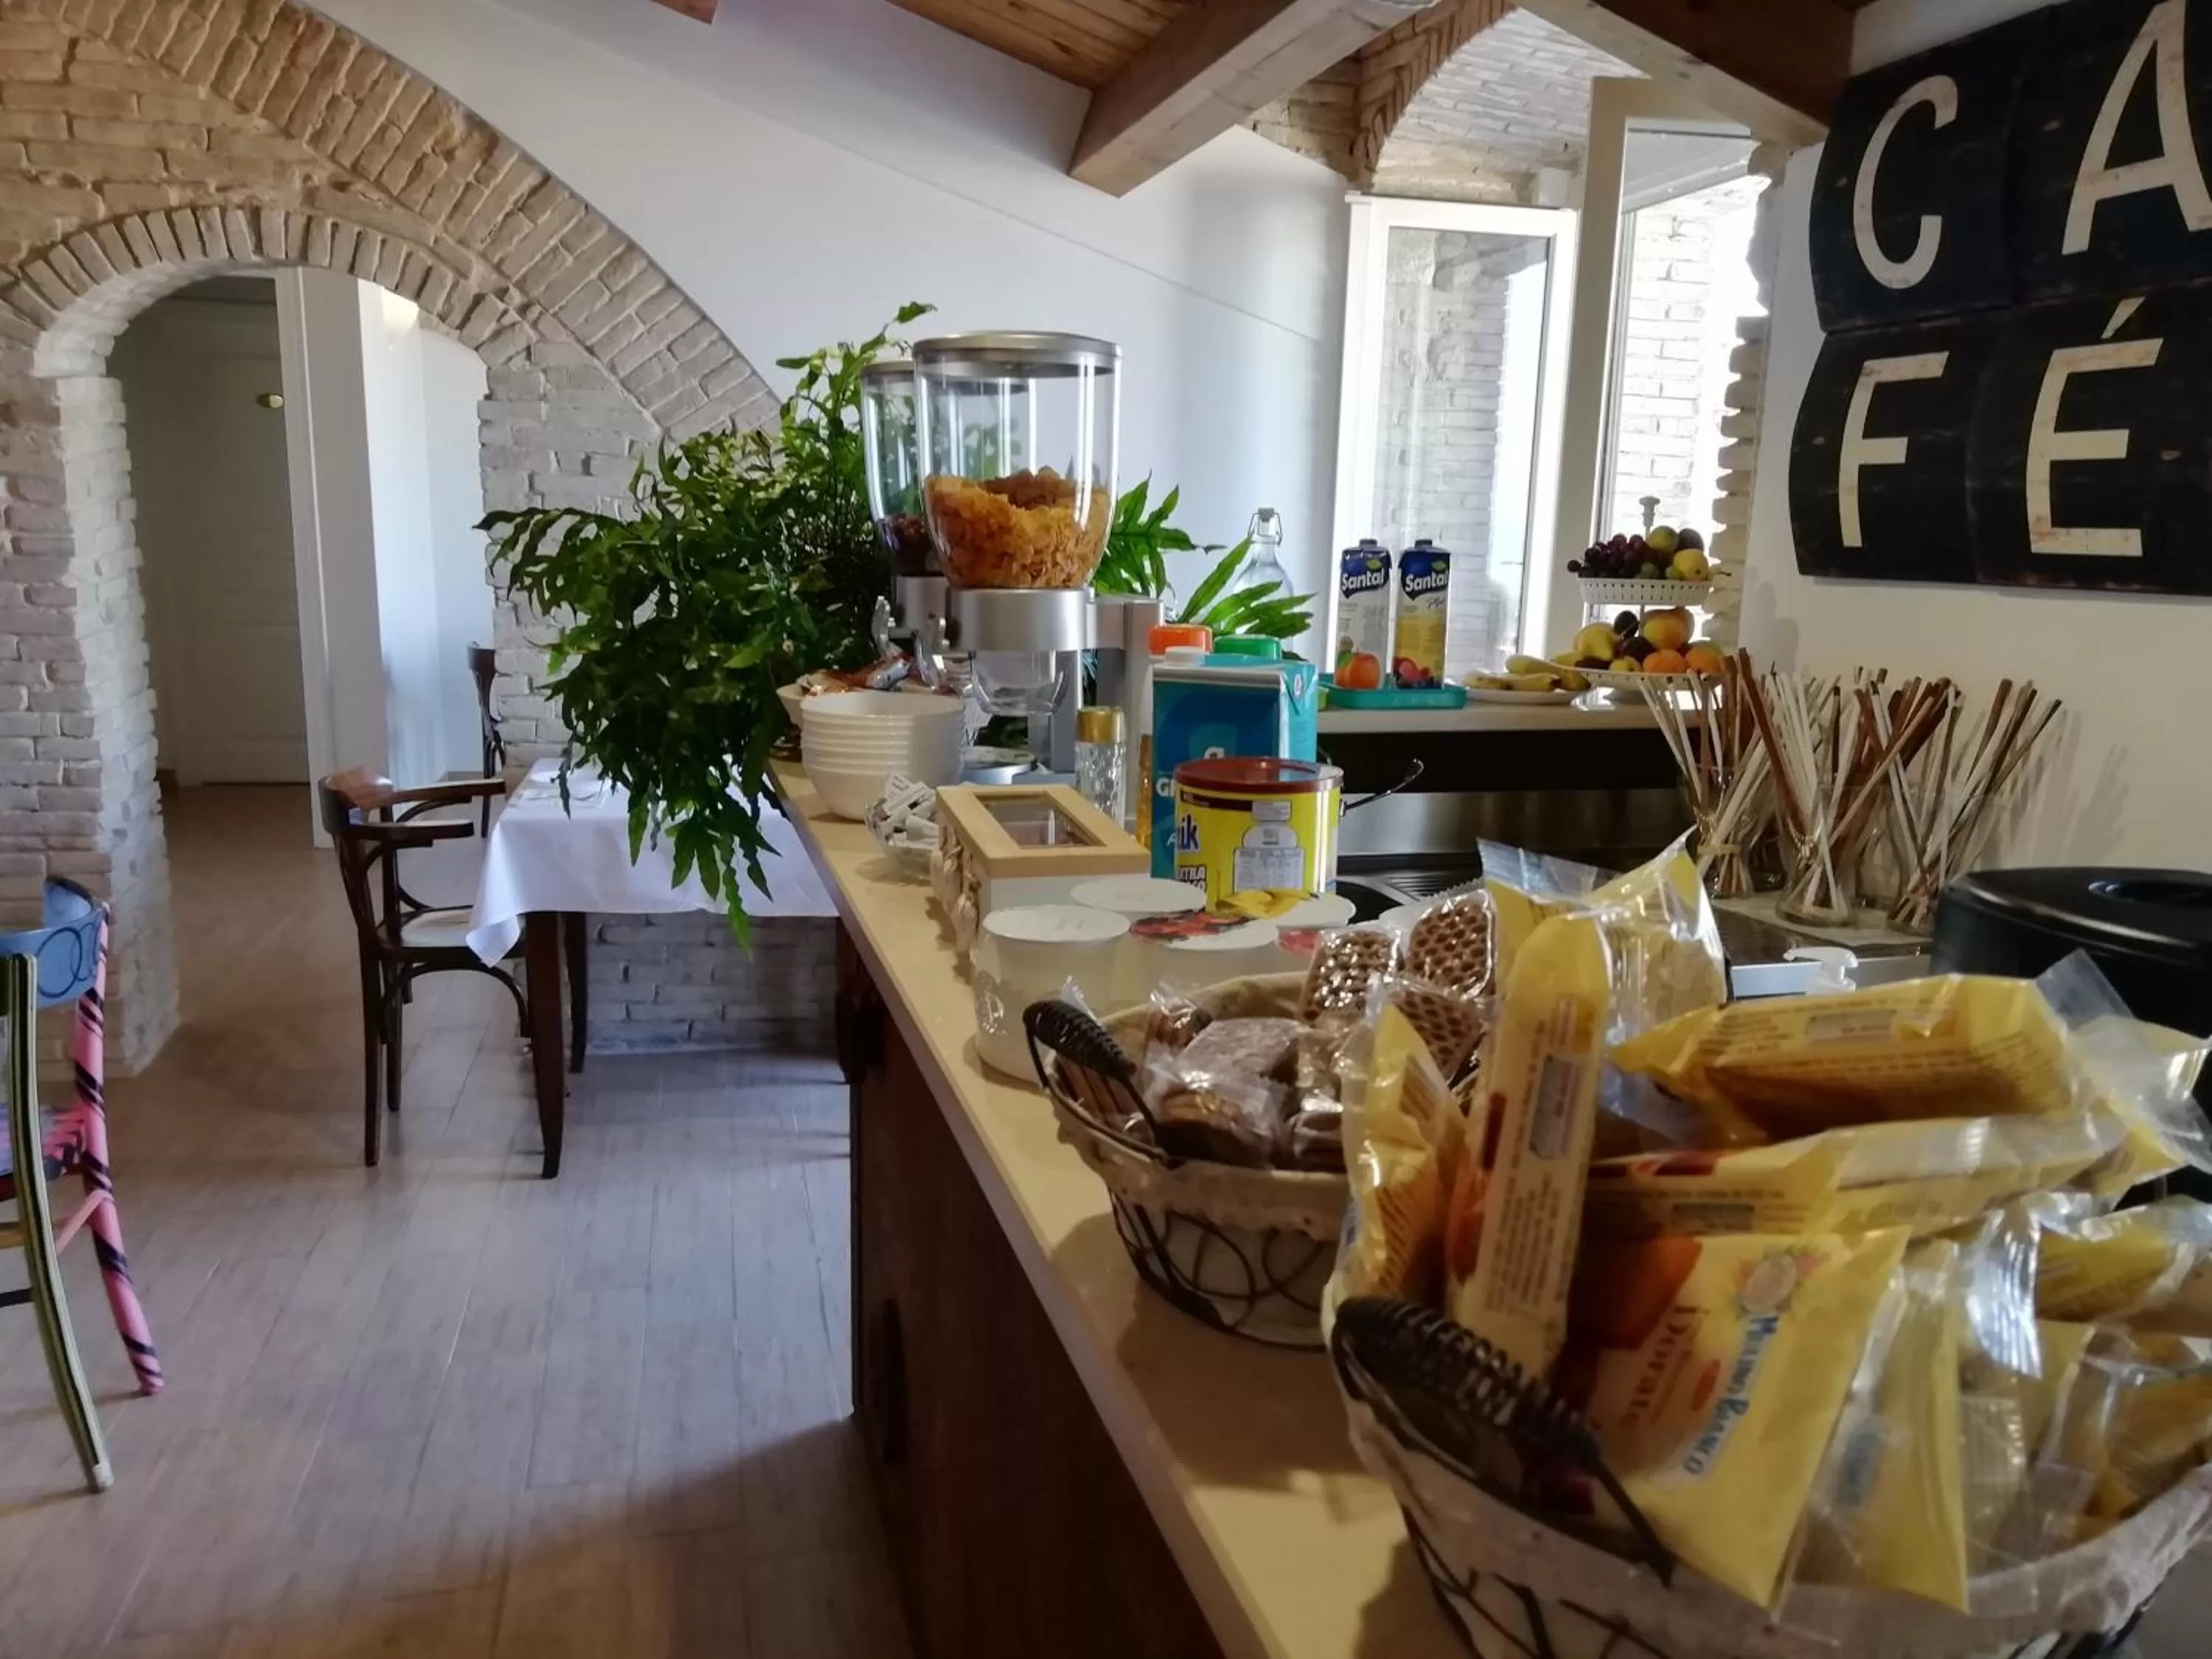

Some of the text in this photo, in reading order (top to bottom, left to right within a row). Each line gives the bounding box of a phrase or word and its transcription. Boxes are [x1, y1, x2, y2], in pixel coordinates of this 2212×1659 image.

[1854, 0, 2212, 289] CA
[1839, 296, 2164, 558] FÉ
[1341, 570, 1385, 591] Santal
[1405, 571, 1450, 592] Santal
